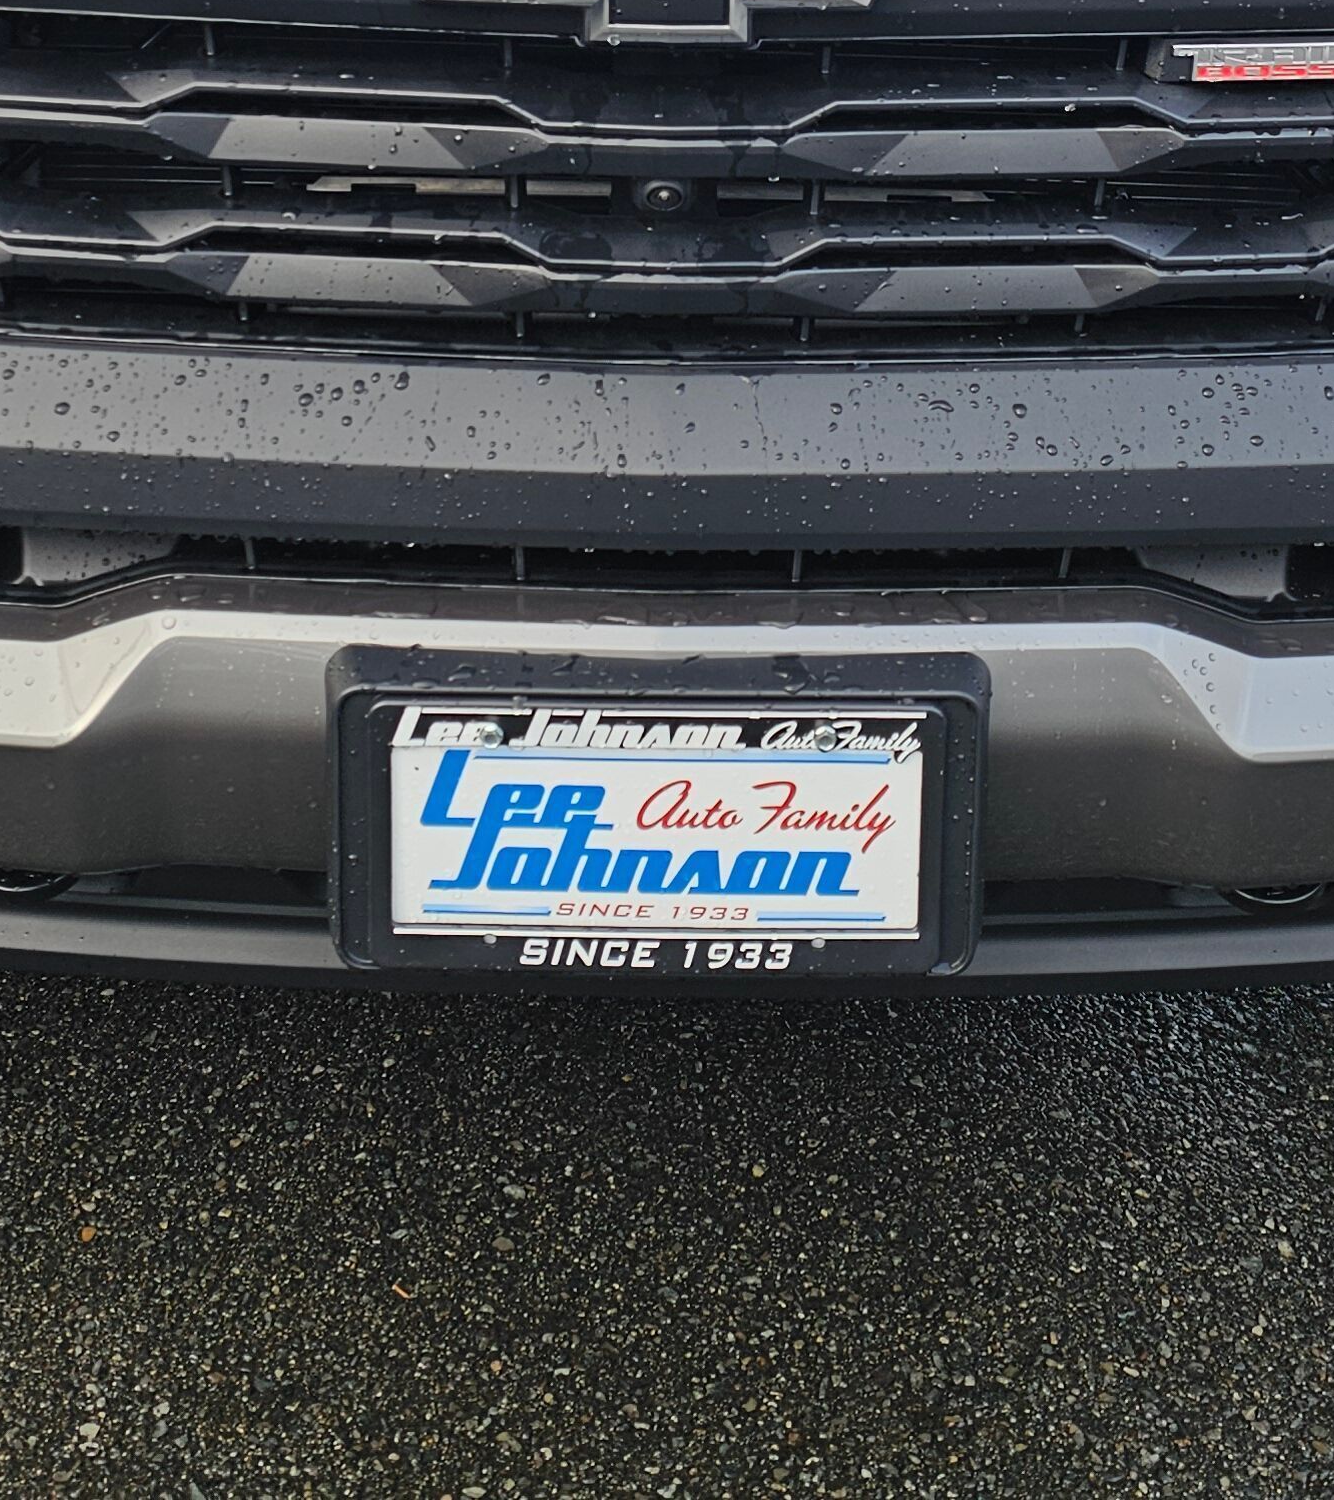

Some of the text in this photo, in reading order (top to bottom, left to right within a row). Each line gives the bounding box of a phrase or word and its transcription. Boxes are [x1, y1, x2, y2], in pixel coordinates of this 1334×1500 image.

[507, 707, 747, 750] Johnson
[761, 721, 831, 750] Aut
[830, 721, 922, 764] Family
[420, 750, 896, 854] Lee Auto Family
[428, 814, 860, 897] Johnson
[555, 902, 750, 922] SINCE 1933
[519, 938, 794, 971] SINCE 1933
